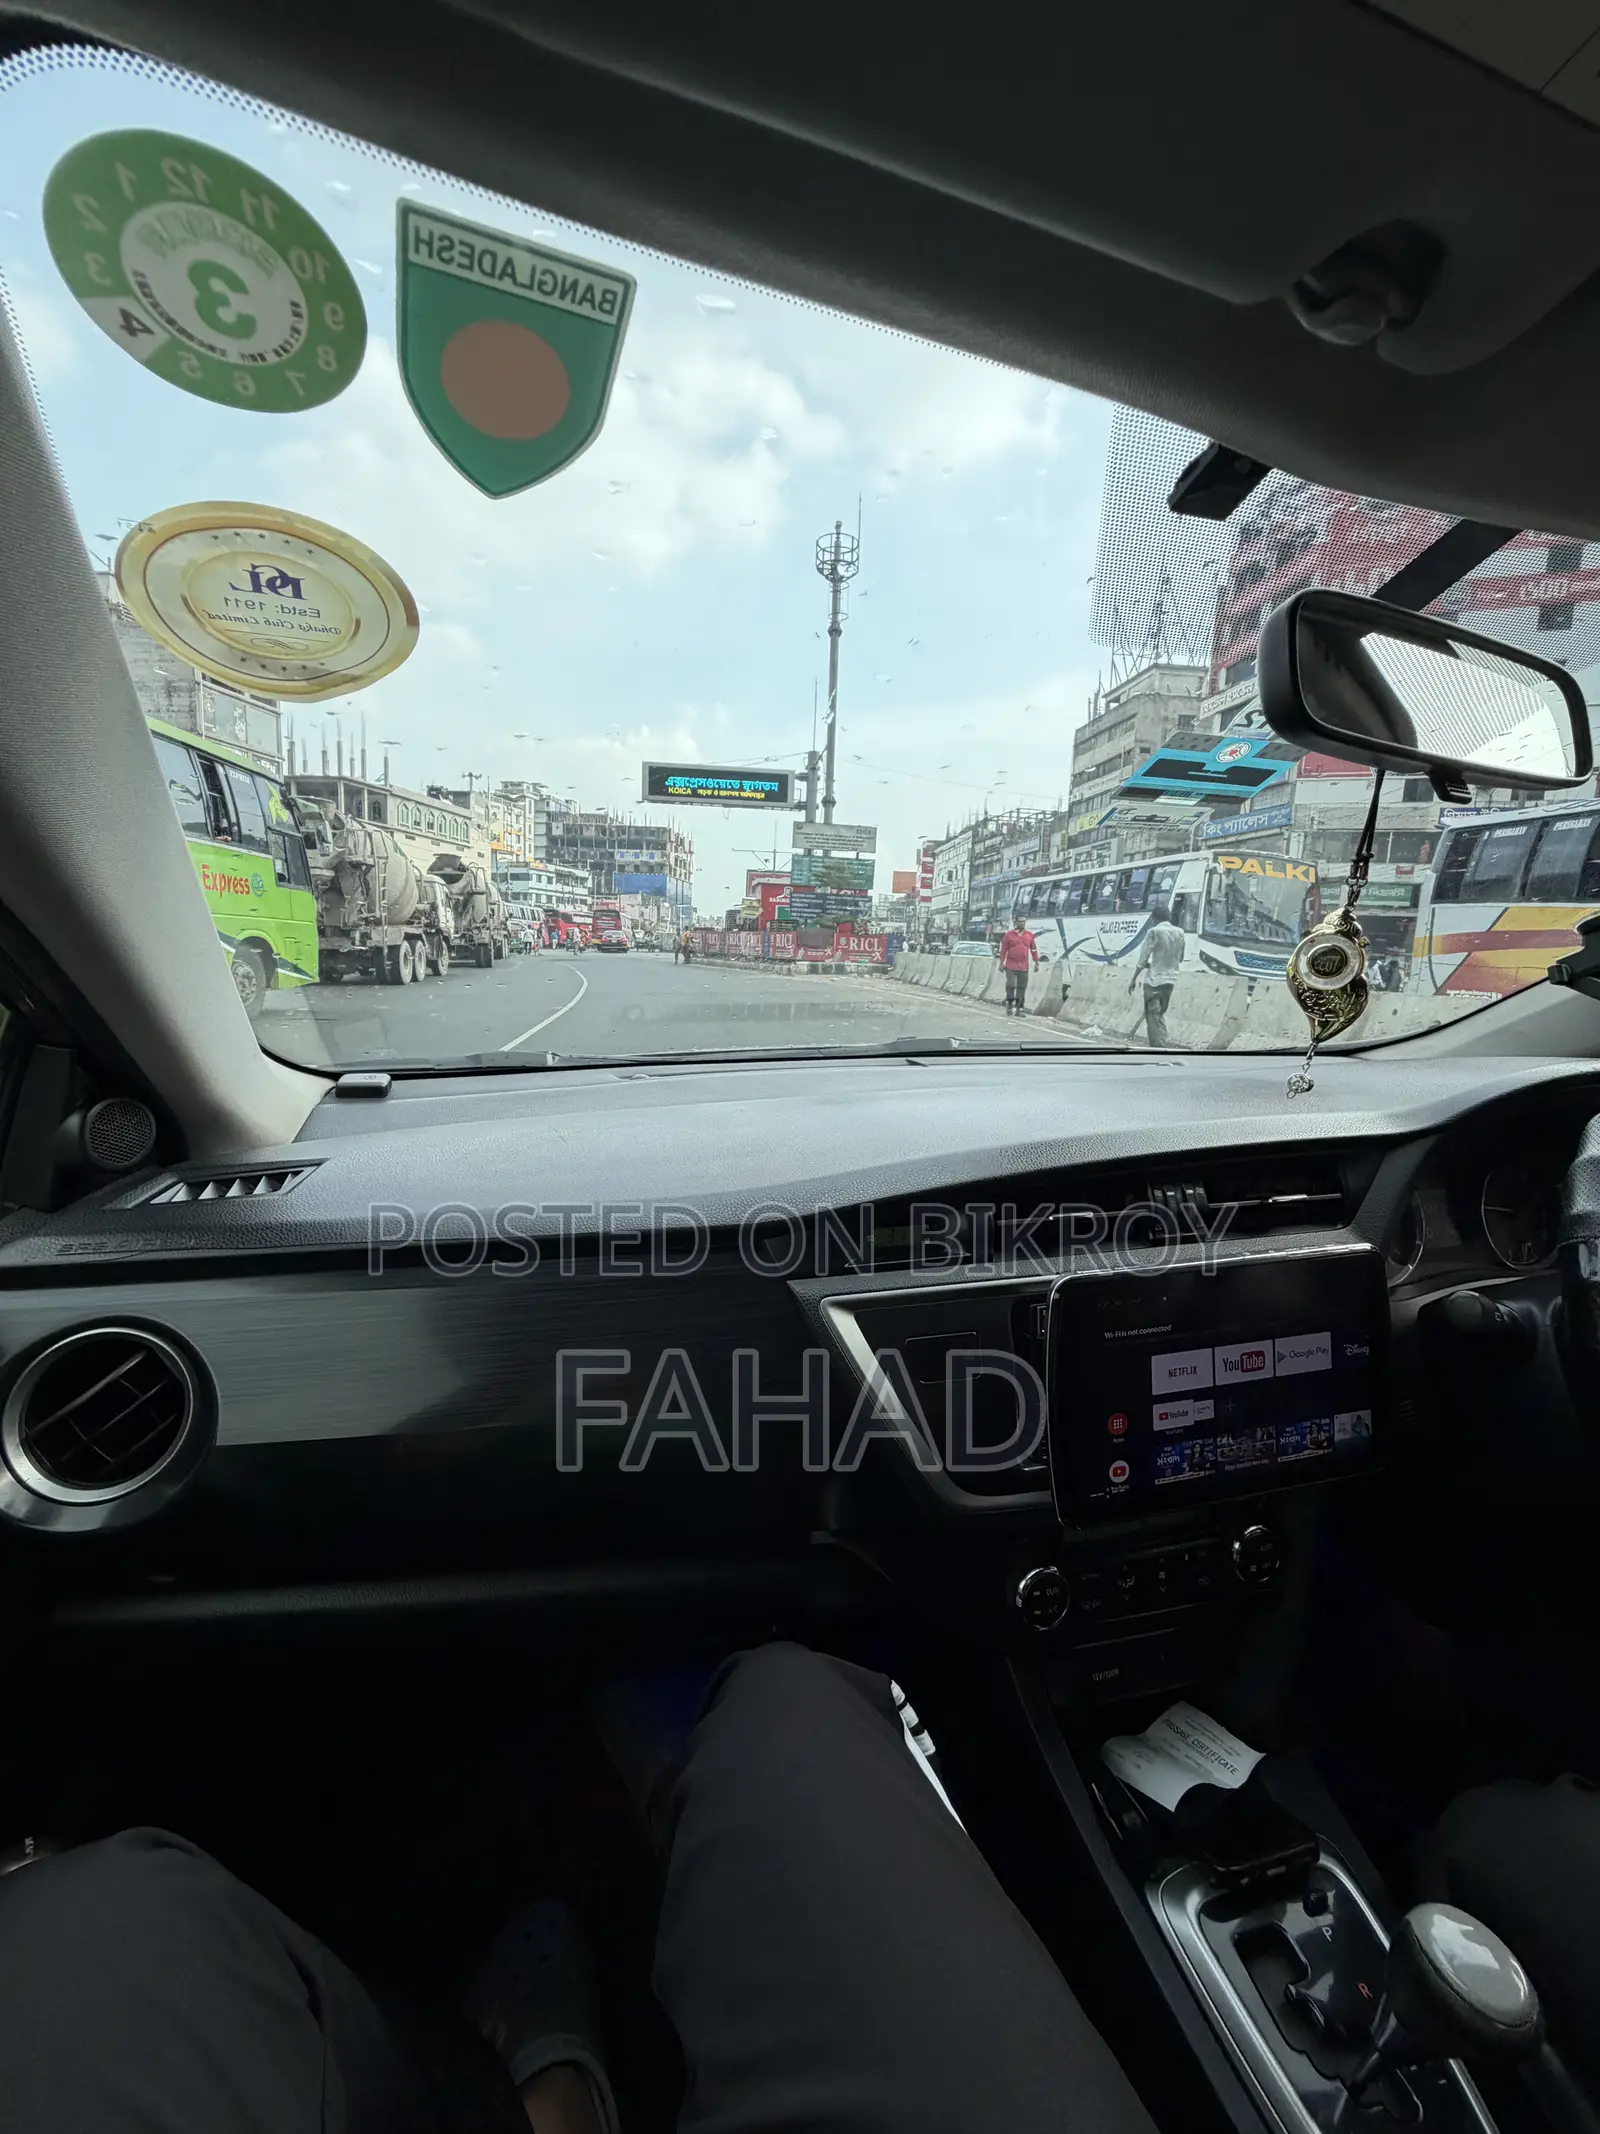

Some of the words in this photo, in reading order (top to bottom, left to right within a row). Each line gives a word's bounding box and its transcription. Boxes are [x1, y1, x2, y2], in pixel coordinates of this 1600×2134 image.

[668, 787, 692, 795] KOICA
[1224, 813, 1269, 833] প্যালেস
[1218, 855, 1316, 883] PALKI
[200, 863, 250, 898] Express
[849, 937, 882, 951] RICL
[1128, 1329, 1139, 1337] not
[1139, 1324, 1172, 1335] connected
[1167, 1365, 1198, 1379] NETFLIX
[1222, 1351, 1266, 1374] YouTube
[1288, 1347, 1315, 1360] Google
[1315, 1345, 1330, 1358] Play
[1168, 1408, 1189, 1420] YouTube
[1191, 1738, 1240, 1776] CERTIFICATE
[1321, 1925, 1333, 1943] P
[1357, 1981, 1373, 2000] R
